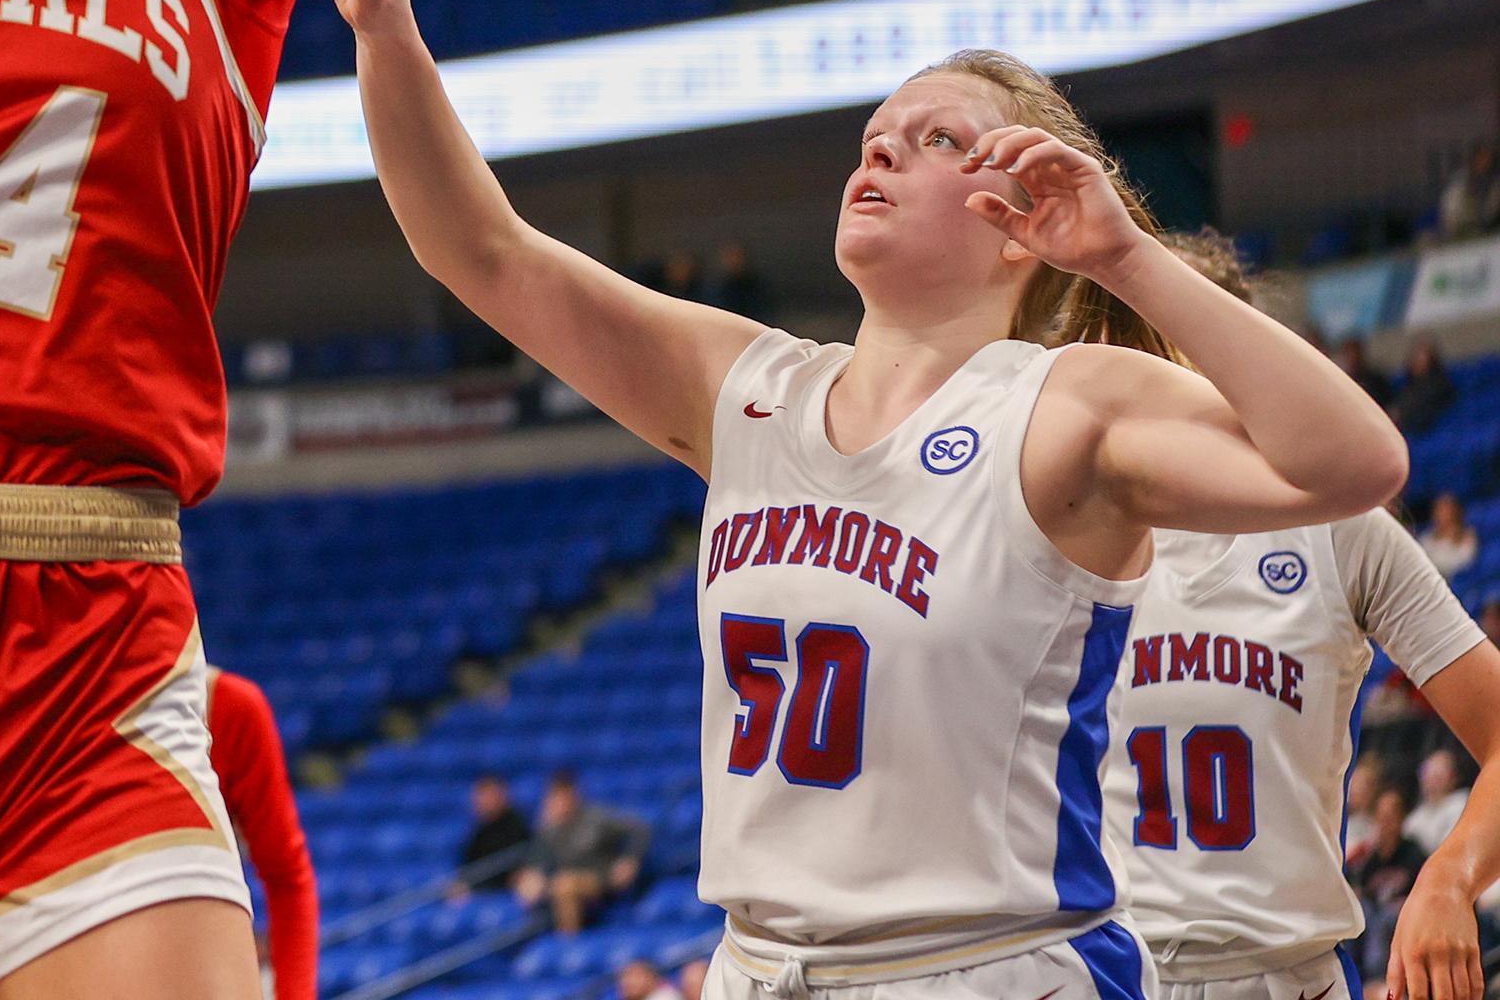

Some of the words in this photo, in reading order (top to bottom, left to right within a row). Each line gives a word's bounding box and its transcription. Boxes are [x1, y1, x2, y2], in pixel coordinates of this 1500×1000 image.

[929, 438, 969, 462] SC
[705, 504, 940, 620] DUNMORE
[1265, 561, 1299, 582] SC
[720, 611, 871, 791] 50
[1131, 631, 1304, 715] NMORE
[1126, 724, 1257, 852] 10
